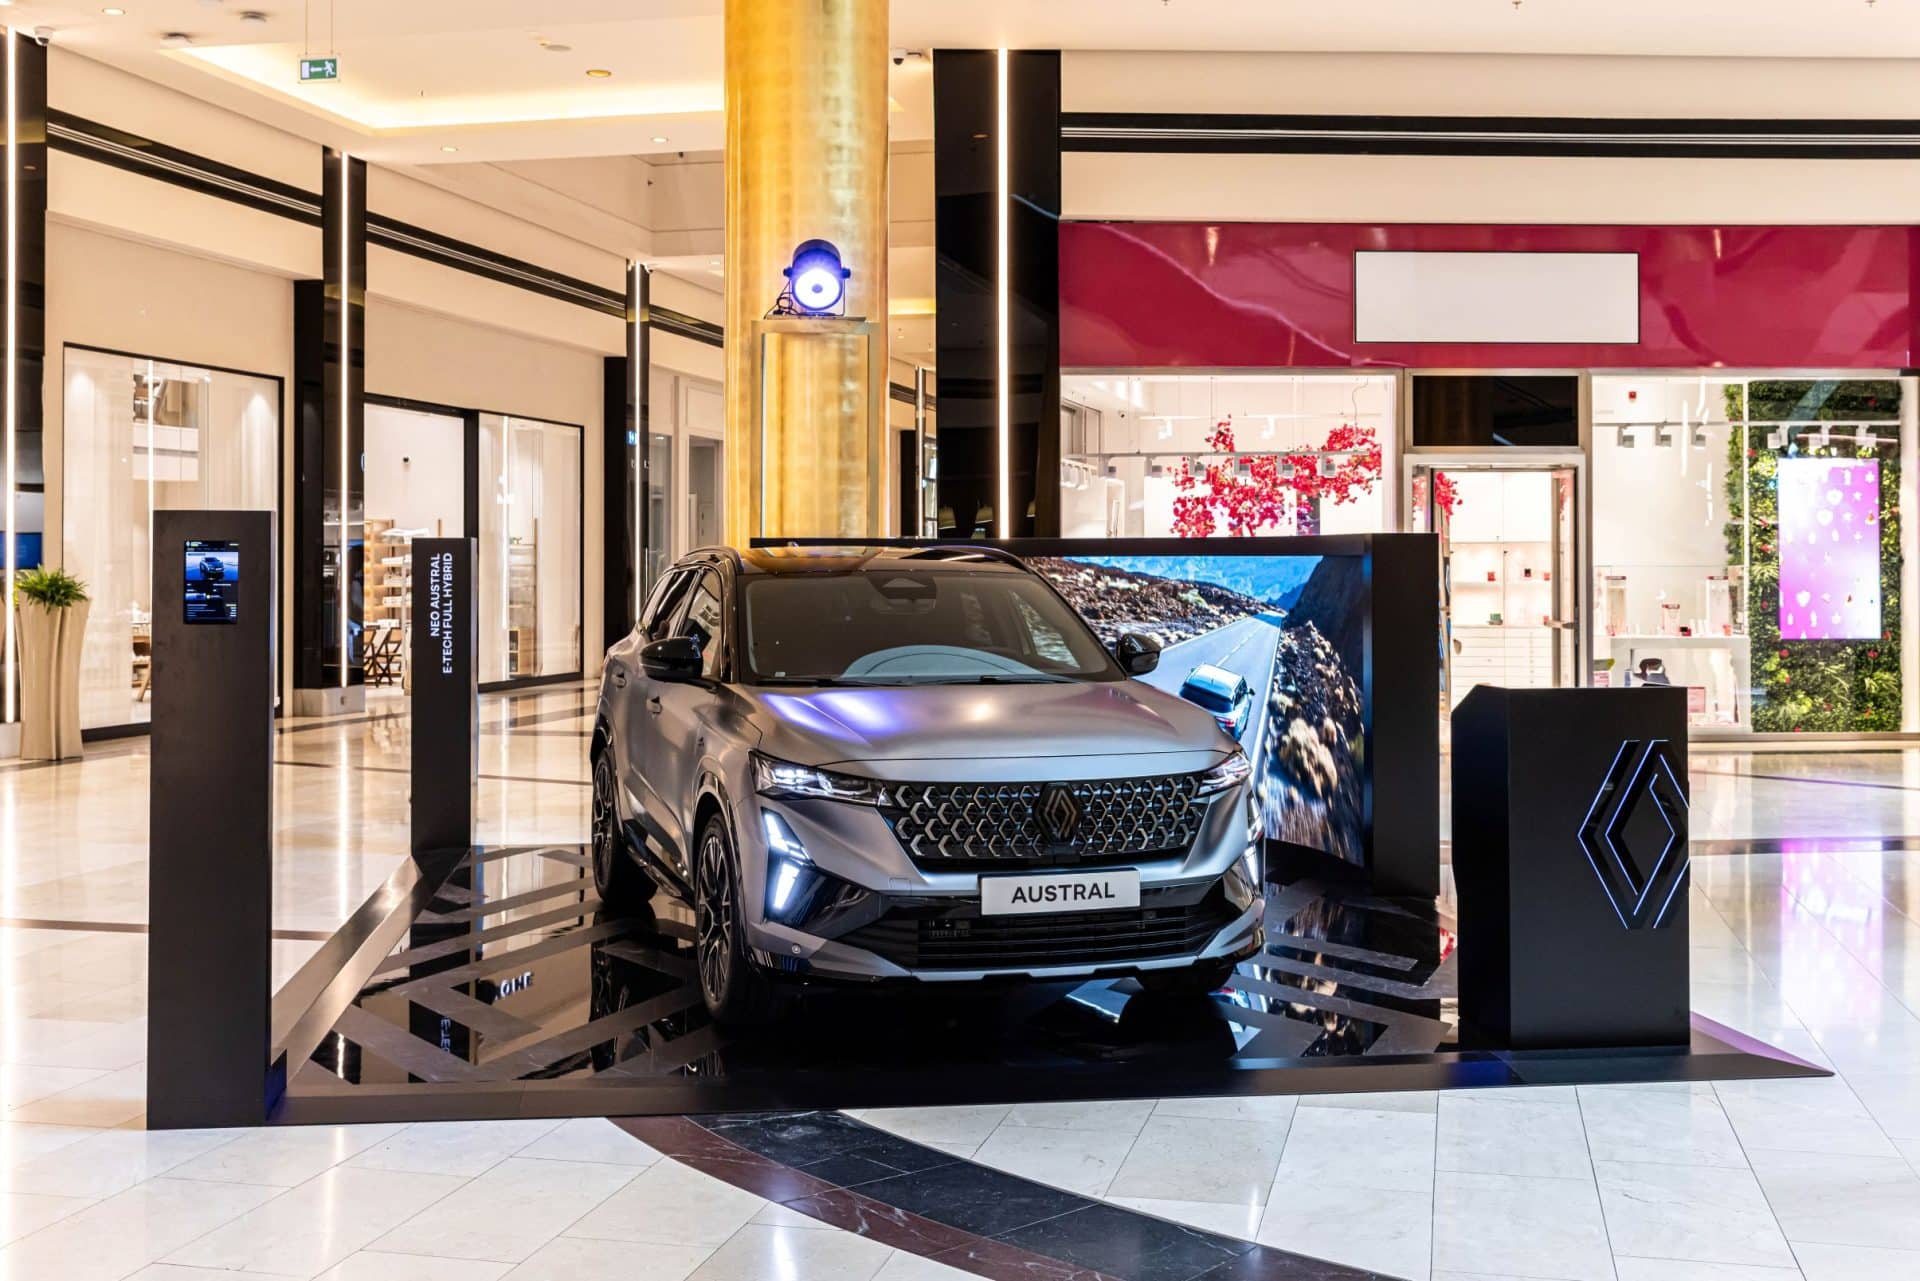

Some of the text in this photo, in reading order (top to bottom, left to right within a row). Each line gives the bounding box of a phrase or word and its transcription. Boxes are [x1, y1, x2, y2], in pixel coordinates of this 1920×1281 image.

[430, 553, 440, 637] NEO AUSTRAL
[443, 552, 453, 674] E-TECH FULL HYBRID
[1011, 882, 1116, 904] AUSTRAL
